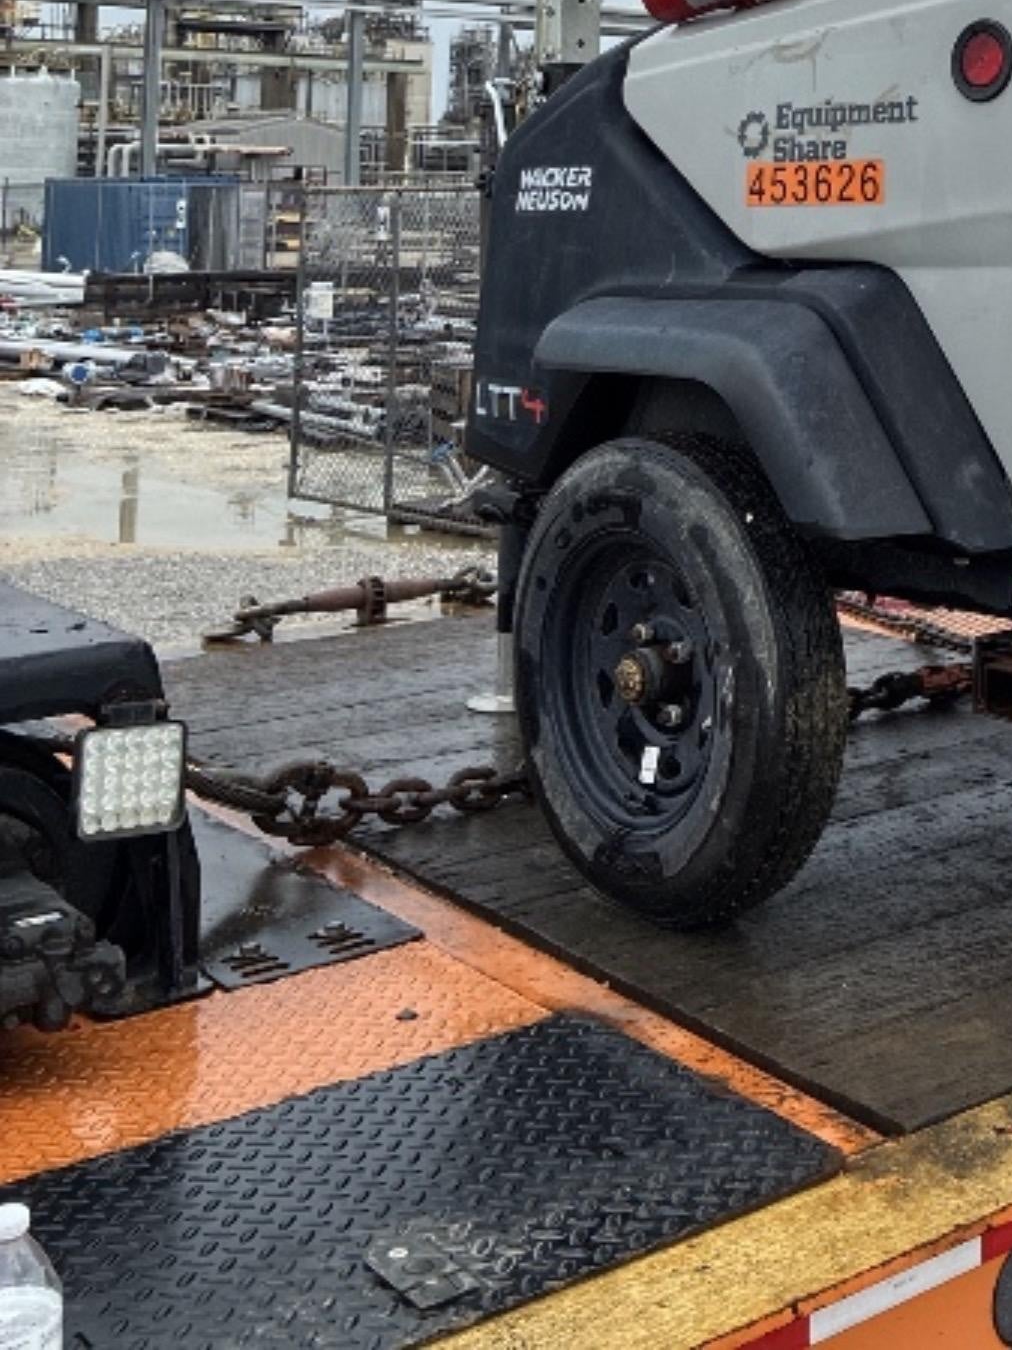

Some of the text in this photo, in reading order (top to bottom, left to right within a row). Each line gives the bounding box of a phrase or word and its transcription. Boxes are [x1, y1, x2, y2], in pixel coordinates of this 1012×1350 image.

[776, 96, 918, 135] Equipment
[773, 137, 848, 162] Share
[521, 166, 592, 189] WACKER
[749, 162, 881, 204] 453626
[515, 190, 589, 214] NEUSON
[475, 381, 545, 424] LTT4
